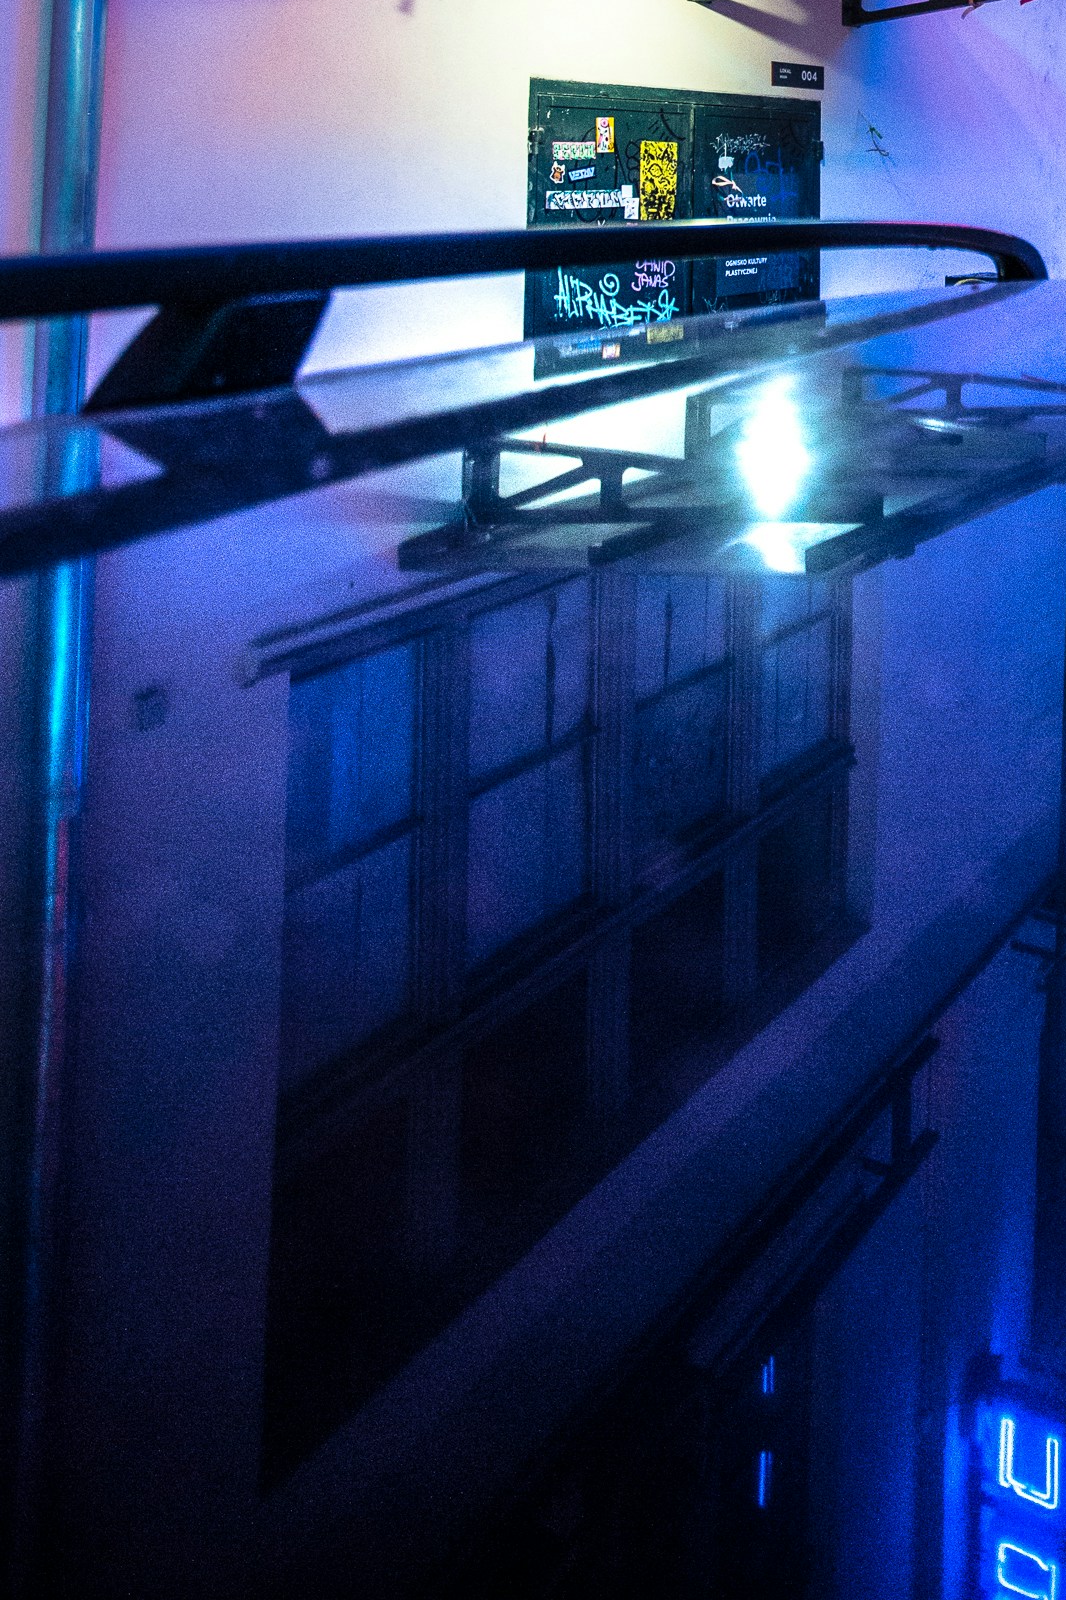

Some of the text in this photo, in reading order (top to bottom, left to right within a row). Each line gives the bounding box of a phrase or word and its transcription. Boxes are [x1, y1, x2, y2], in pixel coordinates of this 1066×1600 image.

[801, 70, 818, 82] 004
[726, 194, 767, 208] Otwarte
[725, 267, 758, 277] PLASTYCZNEJ
